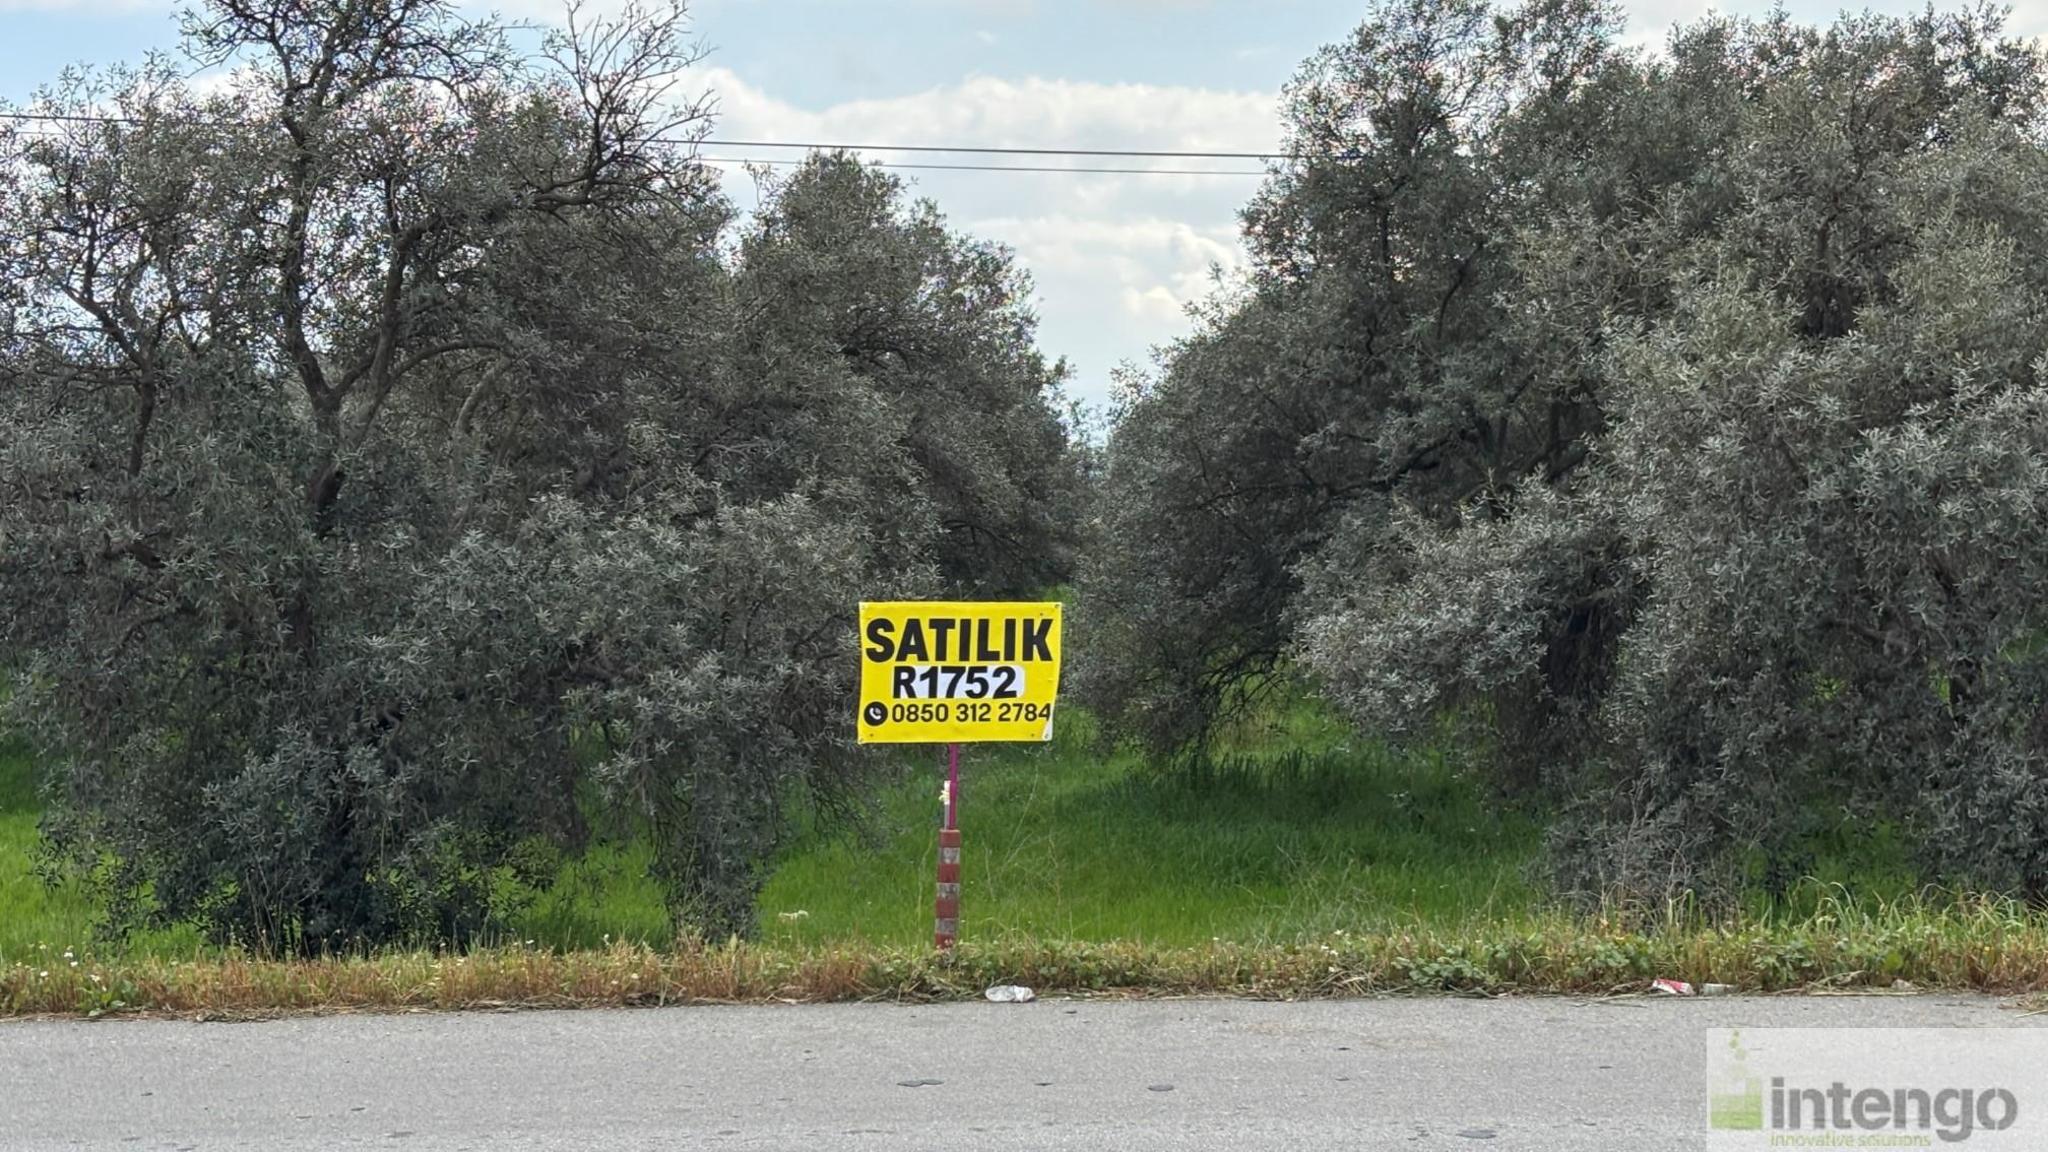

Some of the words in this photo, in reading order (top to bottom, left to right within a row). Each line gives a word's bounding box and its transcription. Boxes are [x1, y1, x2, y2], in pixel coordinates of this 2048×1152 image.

[866, 617, 1054, 663] SATILIK
[892, 665, 1018, 700] R1752
[891, 703, 949, 723] 0850
[955, 703, 991, 722] 312
[998, 703, 1051, 722] 2784
